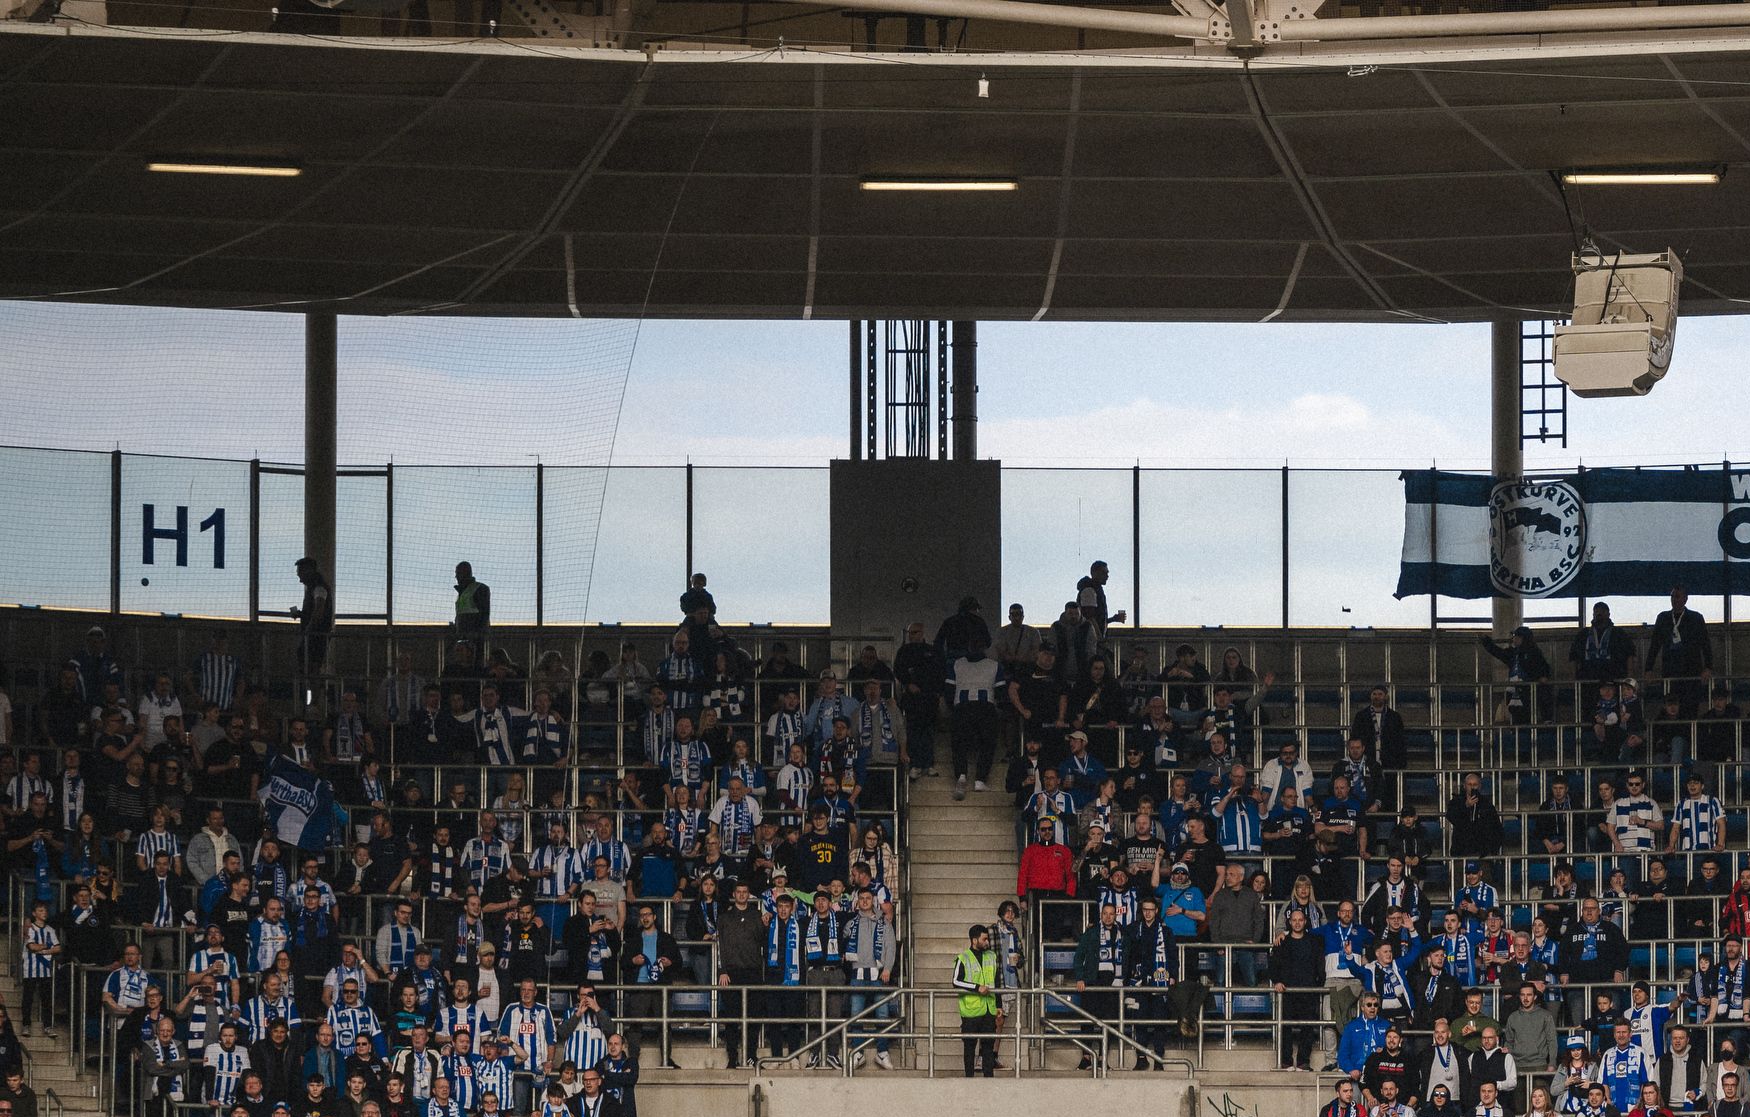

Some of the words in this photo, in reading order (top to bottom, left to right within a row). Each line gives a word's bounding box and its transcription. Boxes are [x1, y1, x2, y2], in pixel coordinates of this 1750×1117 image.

[142, 503, 226, 570] H1
[816, 850, 832, 864] 30
[1572, 931, 1607, 943] BERIN
[521, 1023, 533, 1033] DB
[460, 1066, 472, 1076] DB
